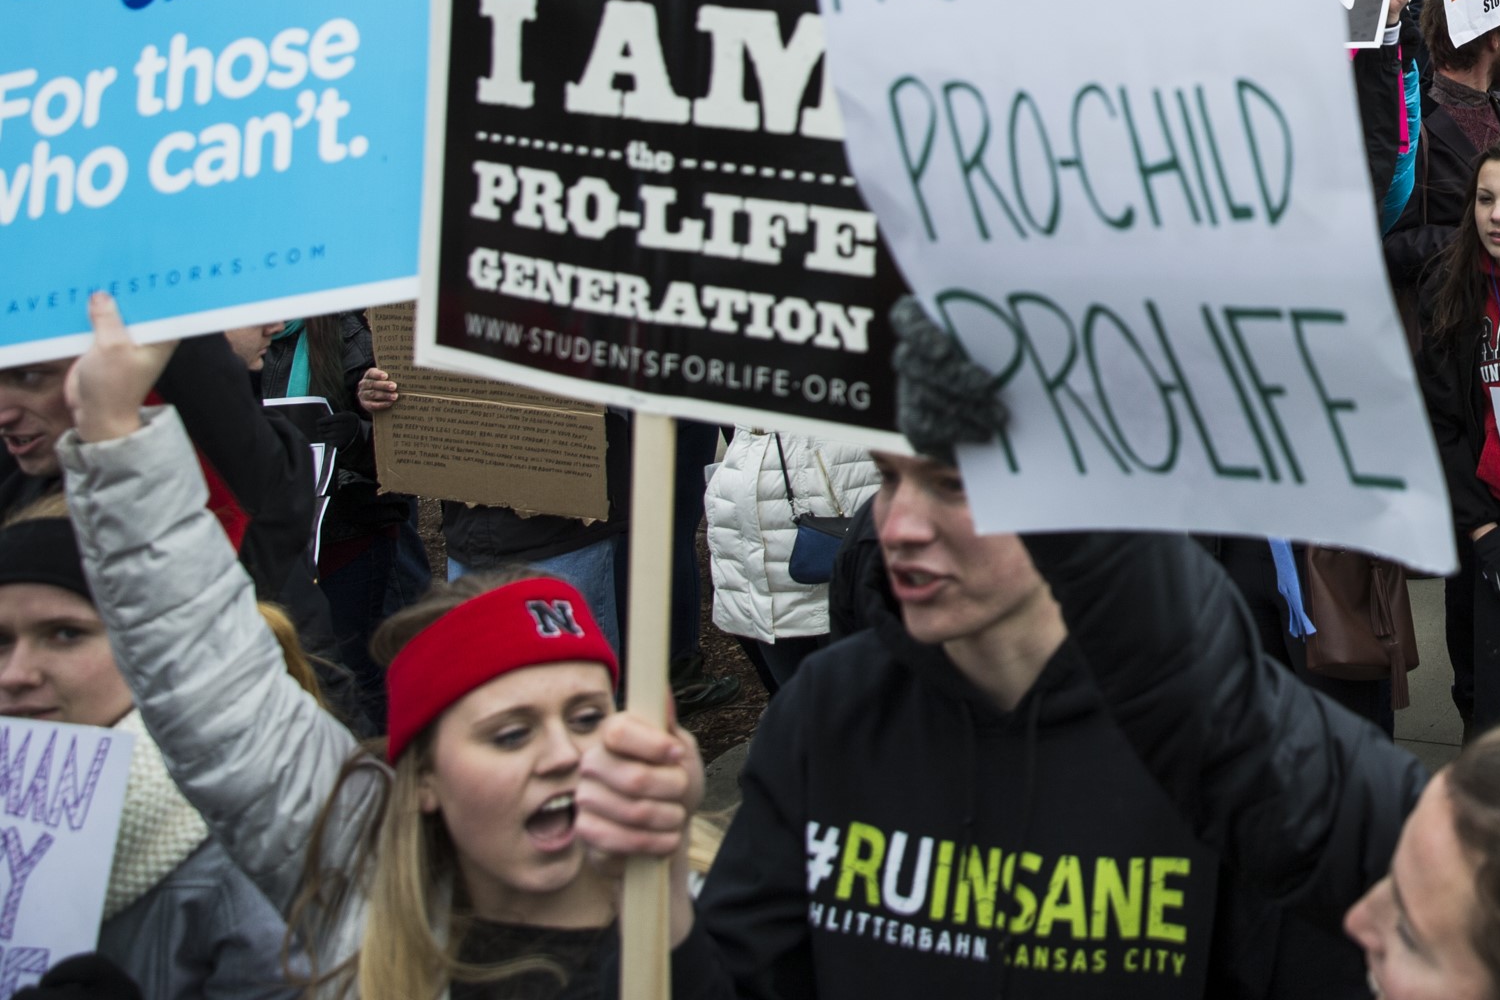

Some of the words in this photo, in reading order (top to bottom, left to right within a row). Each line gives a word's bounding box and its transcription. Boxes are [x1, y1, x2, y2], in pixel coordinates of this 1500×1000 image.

[0, 66, 118, 140] For
[134, 18, 360, 118] those
[564, 0, 846, 142] AM
[626, 140, 674, 174] the
[889, 76, 1295, 243] PRO-CHILD
[470, 161, 878, 277] PRO-LIFE
[468, 247, 875, 353] GENERATION
[525, 599, 586, 640] N
[806, 820, 1191, 943] #RUINSANE
[1003, 944, 1107, 974] ANSAS
[1123, 947, 1186, 977] CITY
